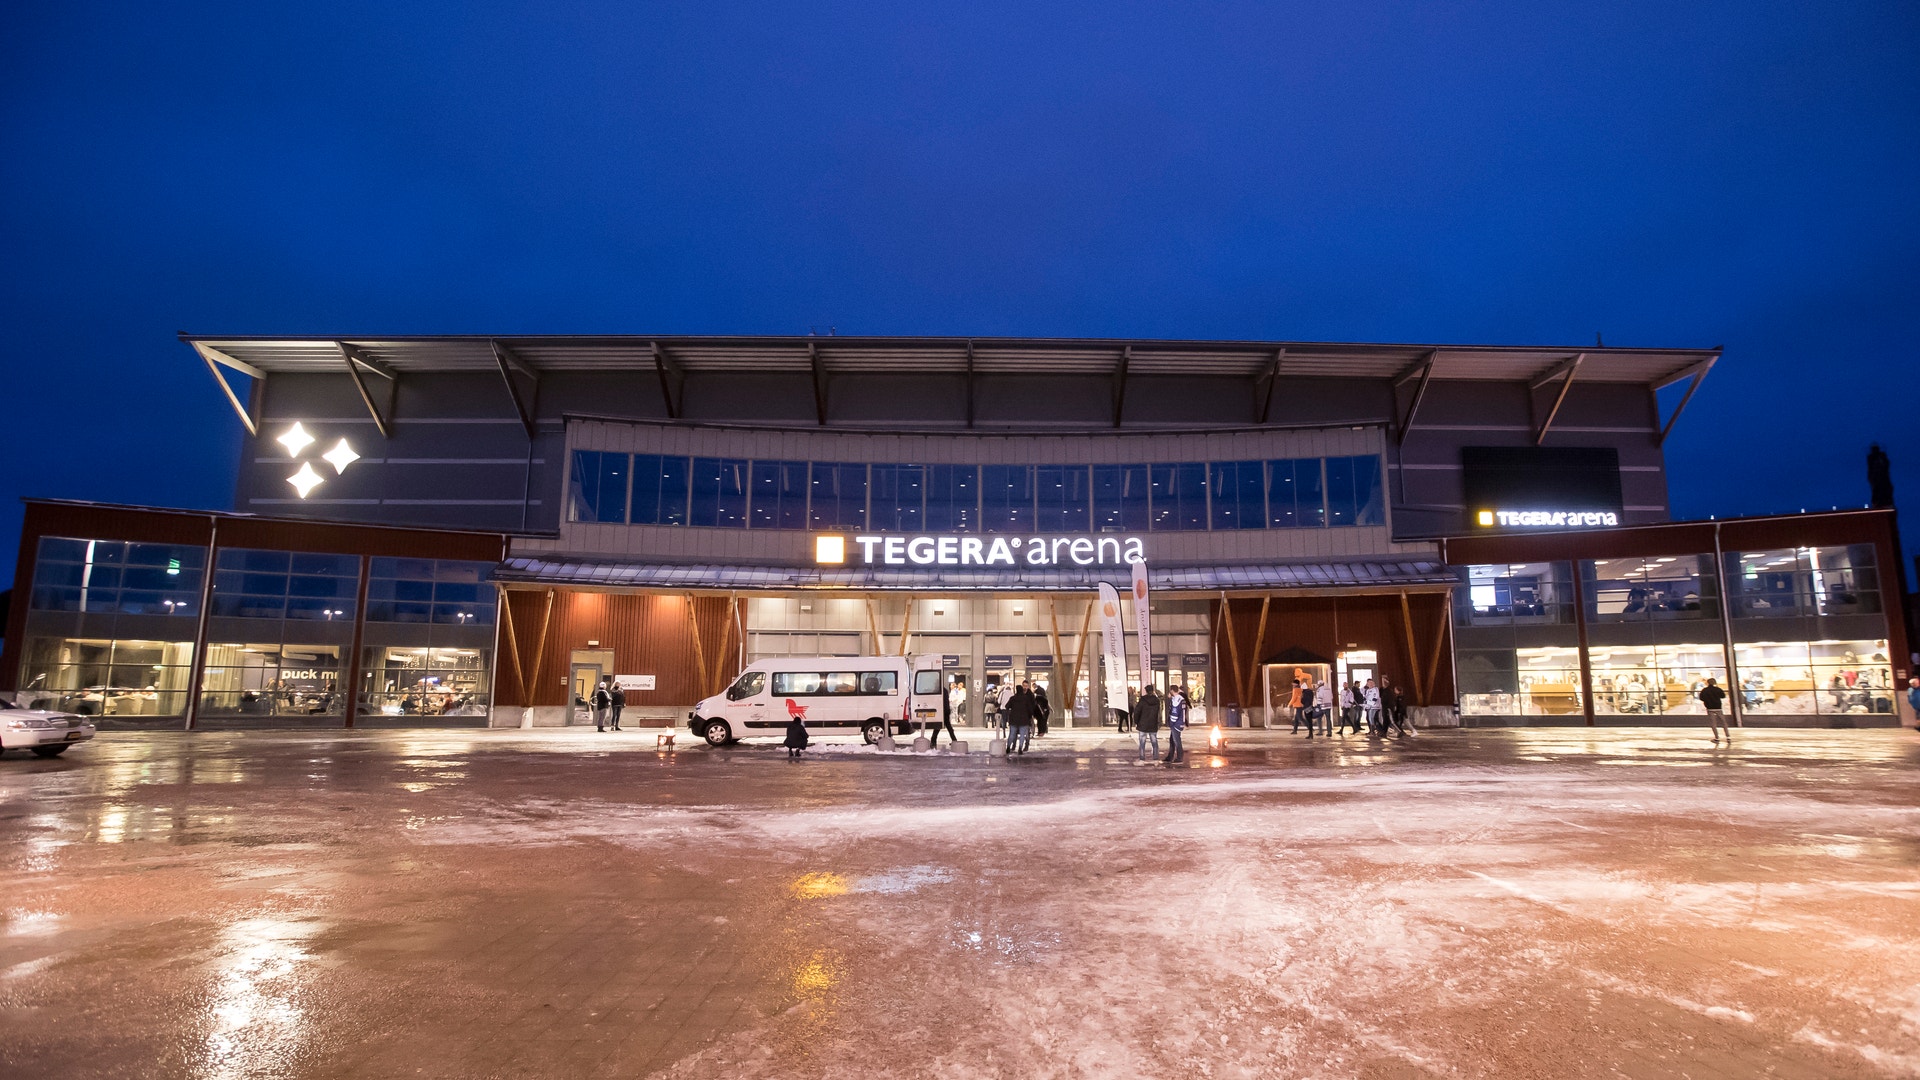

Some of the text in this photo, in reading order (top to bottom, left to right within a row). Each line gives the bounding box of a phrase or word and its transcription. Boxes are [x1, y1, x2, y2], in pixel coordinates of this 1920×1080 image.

[1567, 511, 1618, 526] arena
[1026, 536, 1147, 565] arena
[281, 668, 318, 680] puck
